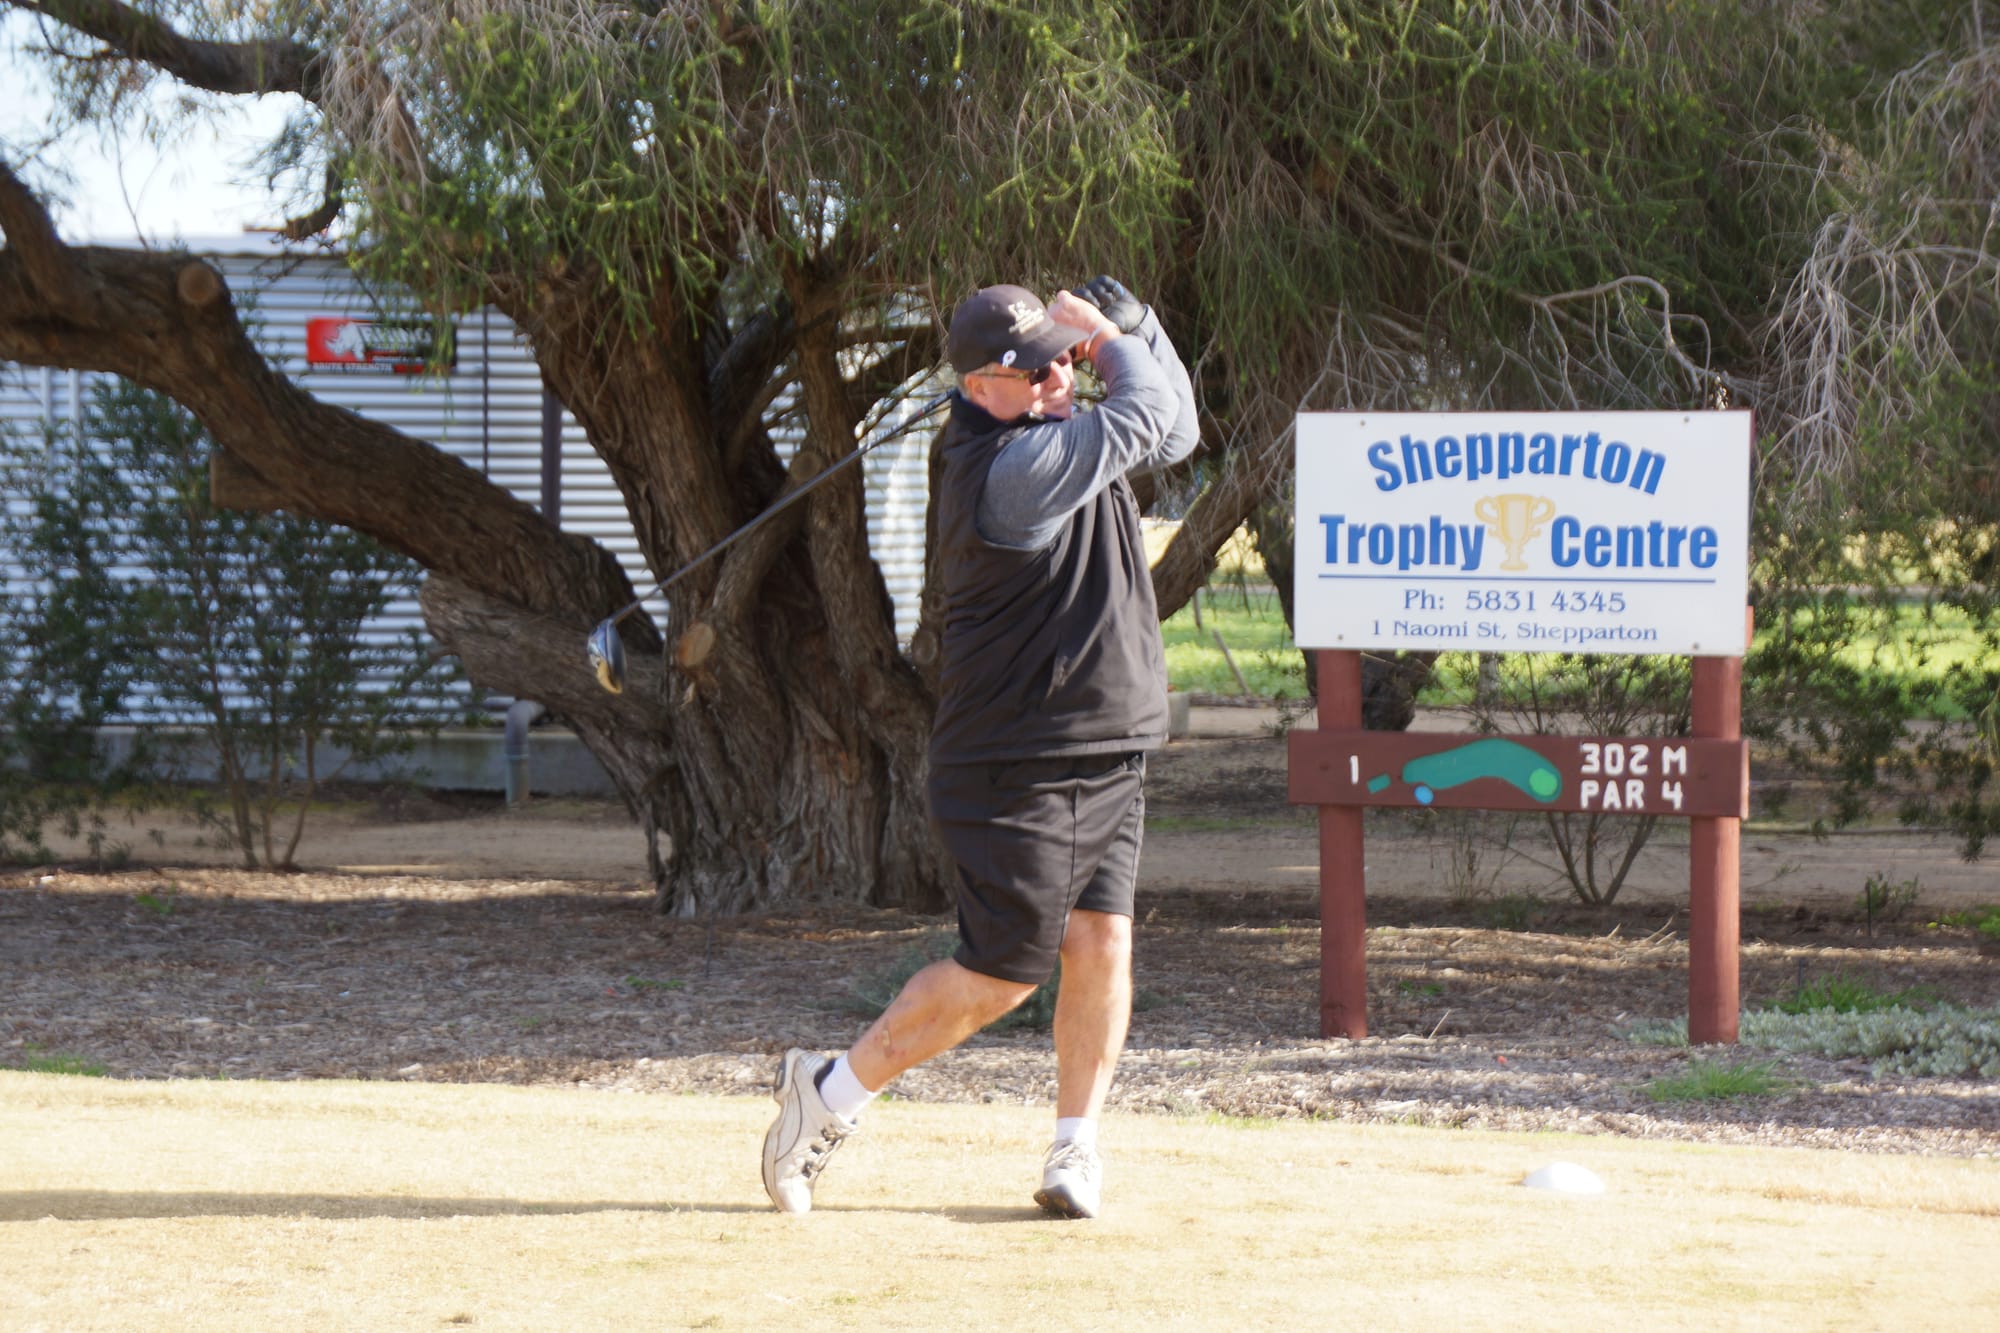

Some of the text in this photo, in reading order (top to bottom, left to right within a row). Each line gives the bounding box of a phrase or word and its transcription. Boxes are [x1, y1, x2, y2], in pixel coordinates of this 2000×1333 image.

[1367, 431, 1667, 496] Shepparton
[1319, 514, 1719, 572] Trophy Centre
[1403, 589, 1627, 614] Ph: 5831 4345
[1373, 620, 1658, 644] 1 Naomi St, Shepparton
[1349, 755, 1360, 785] 1
[1580, 742, 1687, 776] 302 M
[1580, 779, 1684, 810] PAR 4
